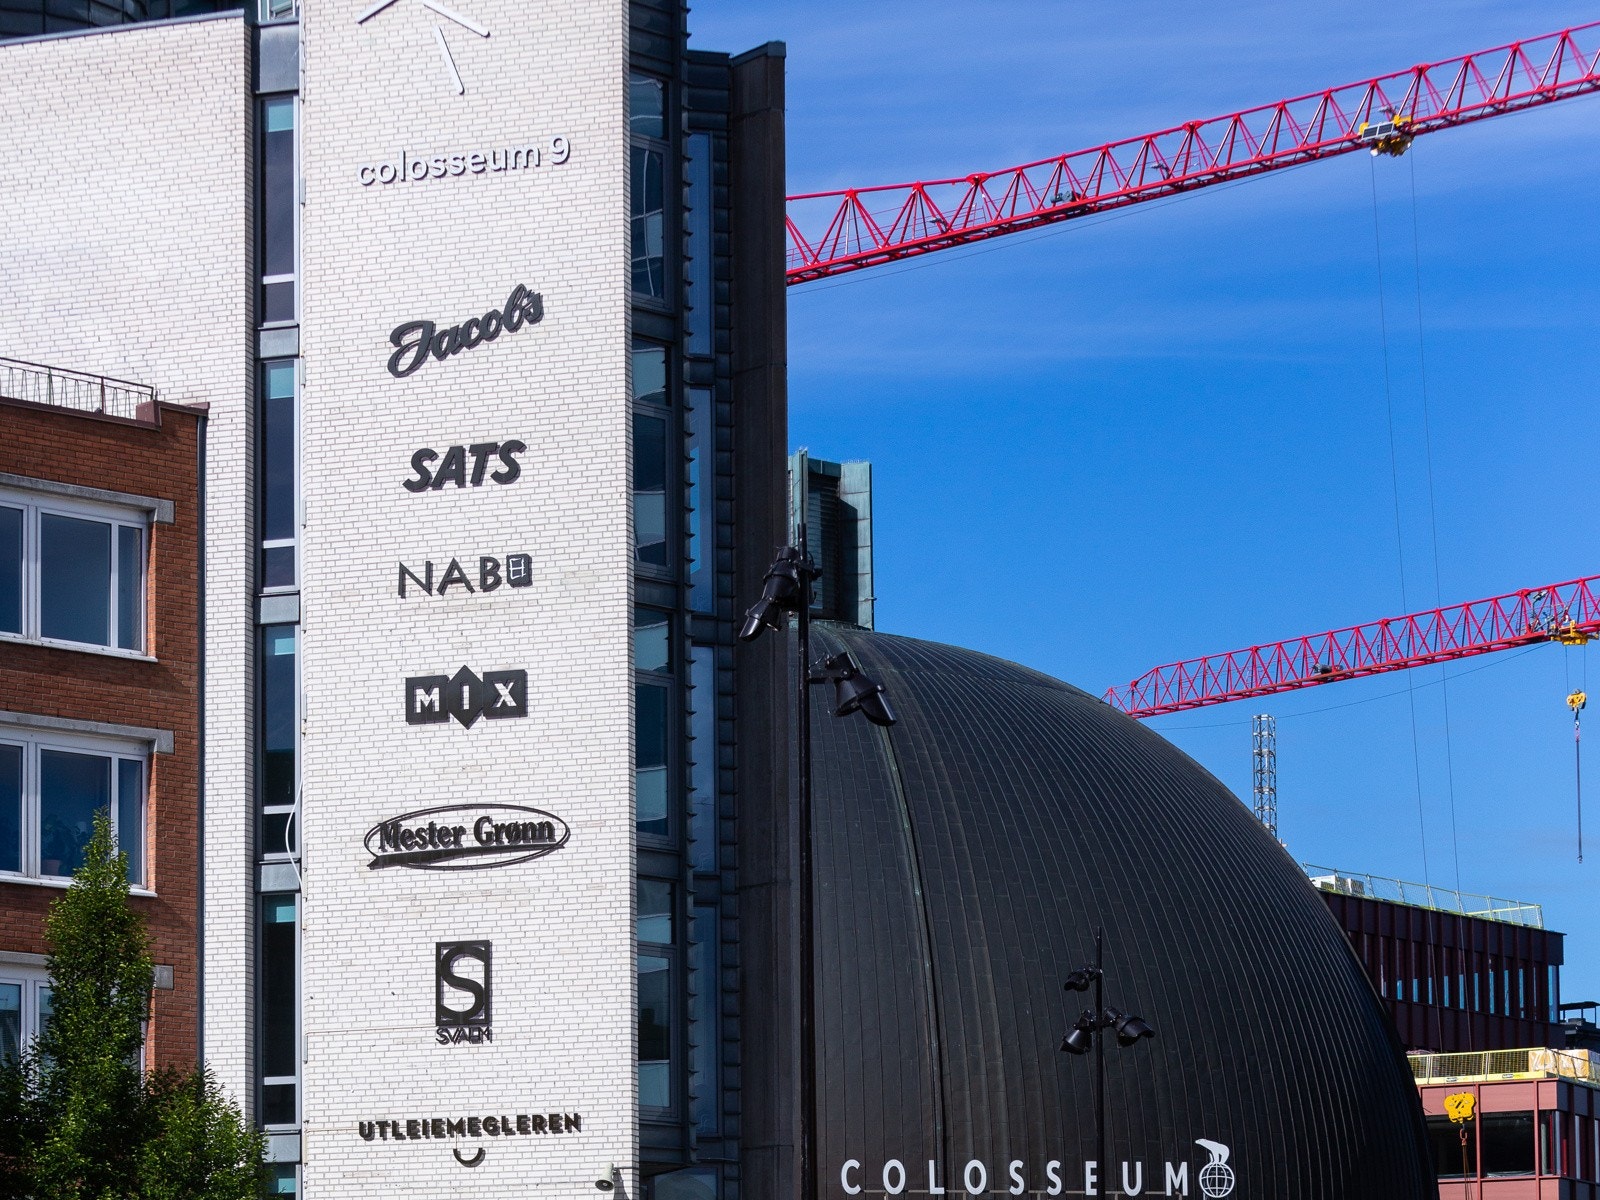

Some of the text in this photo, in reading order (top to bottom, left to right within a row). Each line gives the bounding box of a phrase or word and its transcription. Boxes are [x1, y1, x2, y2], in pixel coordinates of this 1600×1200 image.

[357, 134, 571, 186] colosseum 9
[388, 283, 545, 378] Jacob's
[402, 439, 528, 493] SATS
[378, 815, 557, 853] Mester Grønn
[358, 1112, 582, 1142] UTLEIEMEGLEREN
[840, 1158, 1189, 1197] COLOSSEUM
